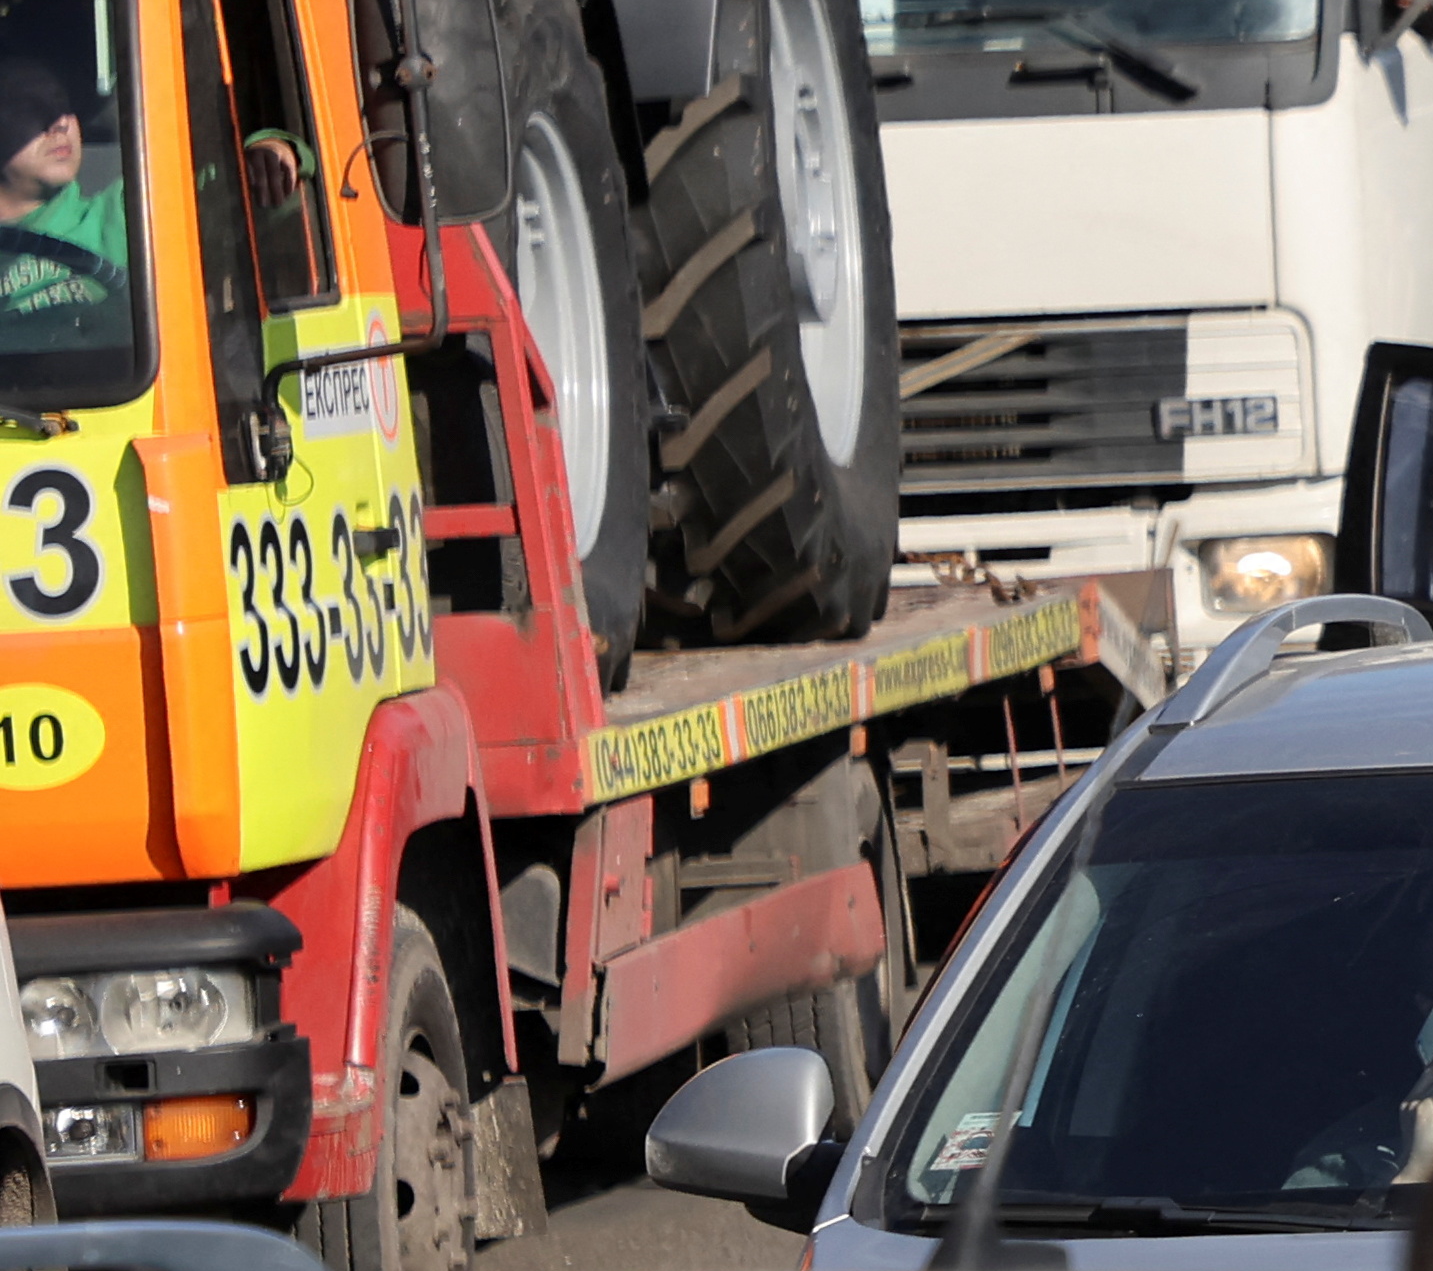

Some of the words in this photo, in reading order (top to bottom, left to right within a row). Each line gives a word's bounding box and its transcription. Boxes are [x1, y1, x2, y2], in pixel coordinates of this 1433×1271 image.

[304, 367, 370, 420] ЕКСПРЕС
[1160, 396, 1278, 440] FH12
[594, 709, 723, 795] (044)383-33-33
